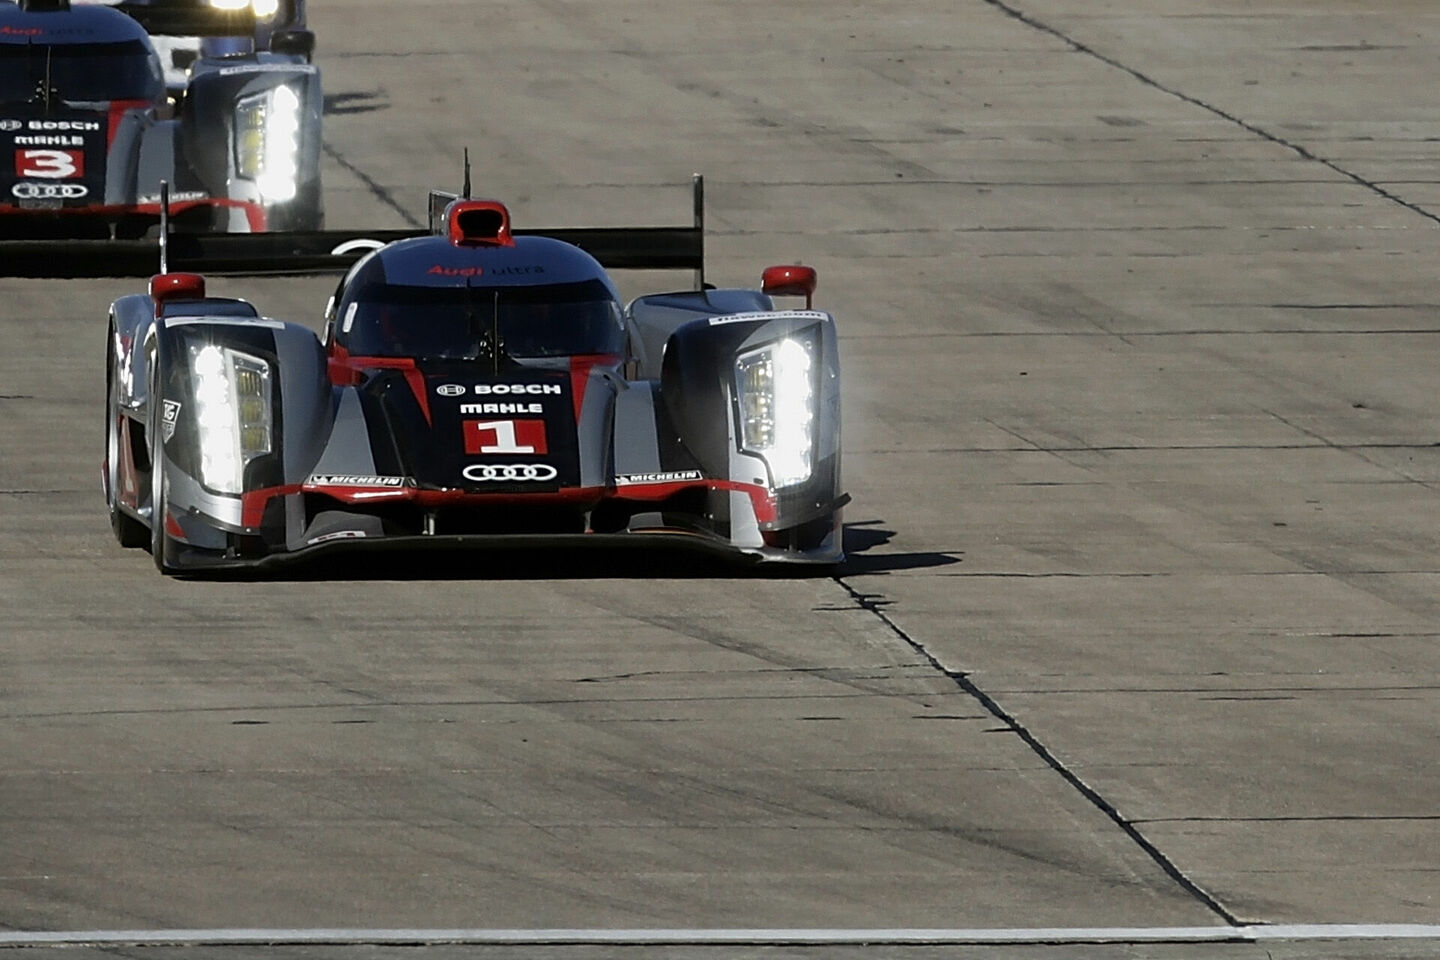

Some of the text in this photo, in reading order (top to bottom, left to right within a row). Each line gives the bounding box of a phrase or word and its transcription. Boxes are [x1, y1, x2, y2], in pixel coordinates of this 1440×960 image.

[28, 121, 100, 131] BOSCH
[14, 136, 84, 145] MAHLE
[23, 149, 77, 179] 3
[427, 265, 484, 277] Audi
[474, 384, 562, 395] BOSCH
[460, 403, 544, 414] MAHLE
[477, 419, 536, 454] 1
[330, 474, 403, 486] MICHELIN
[629, 470, 697, 482] MICHELIN
